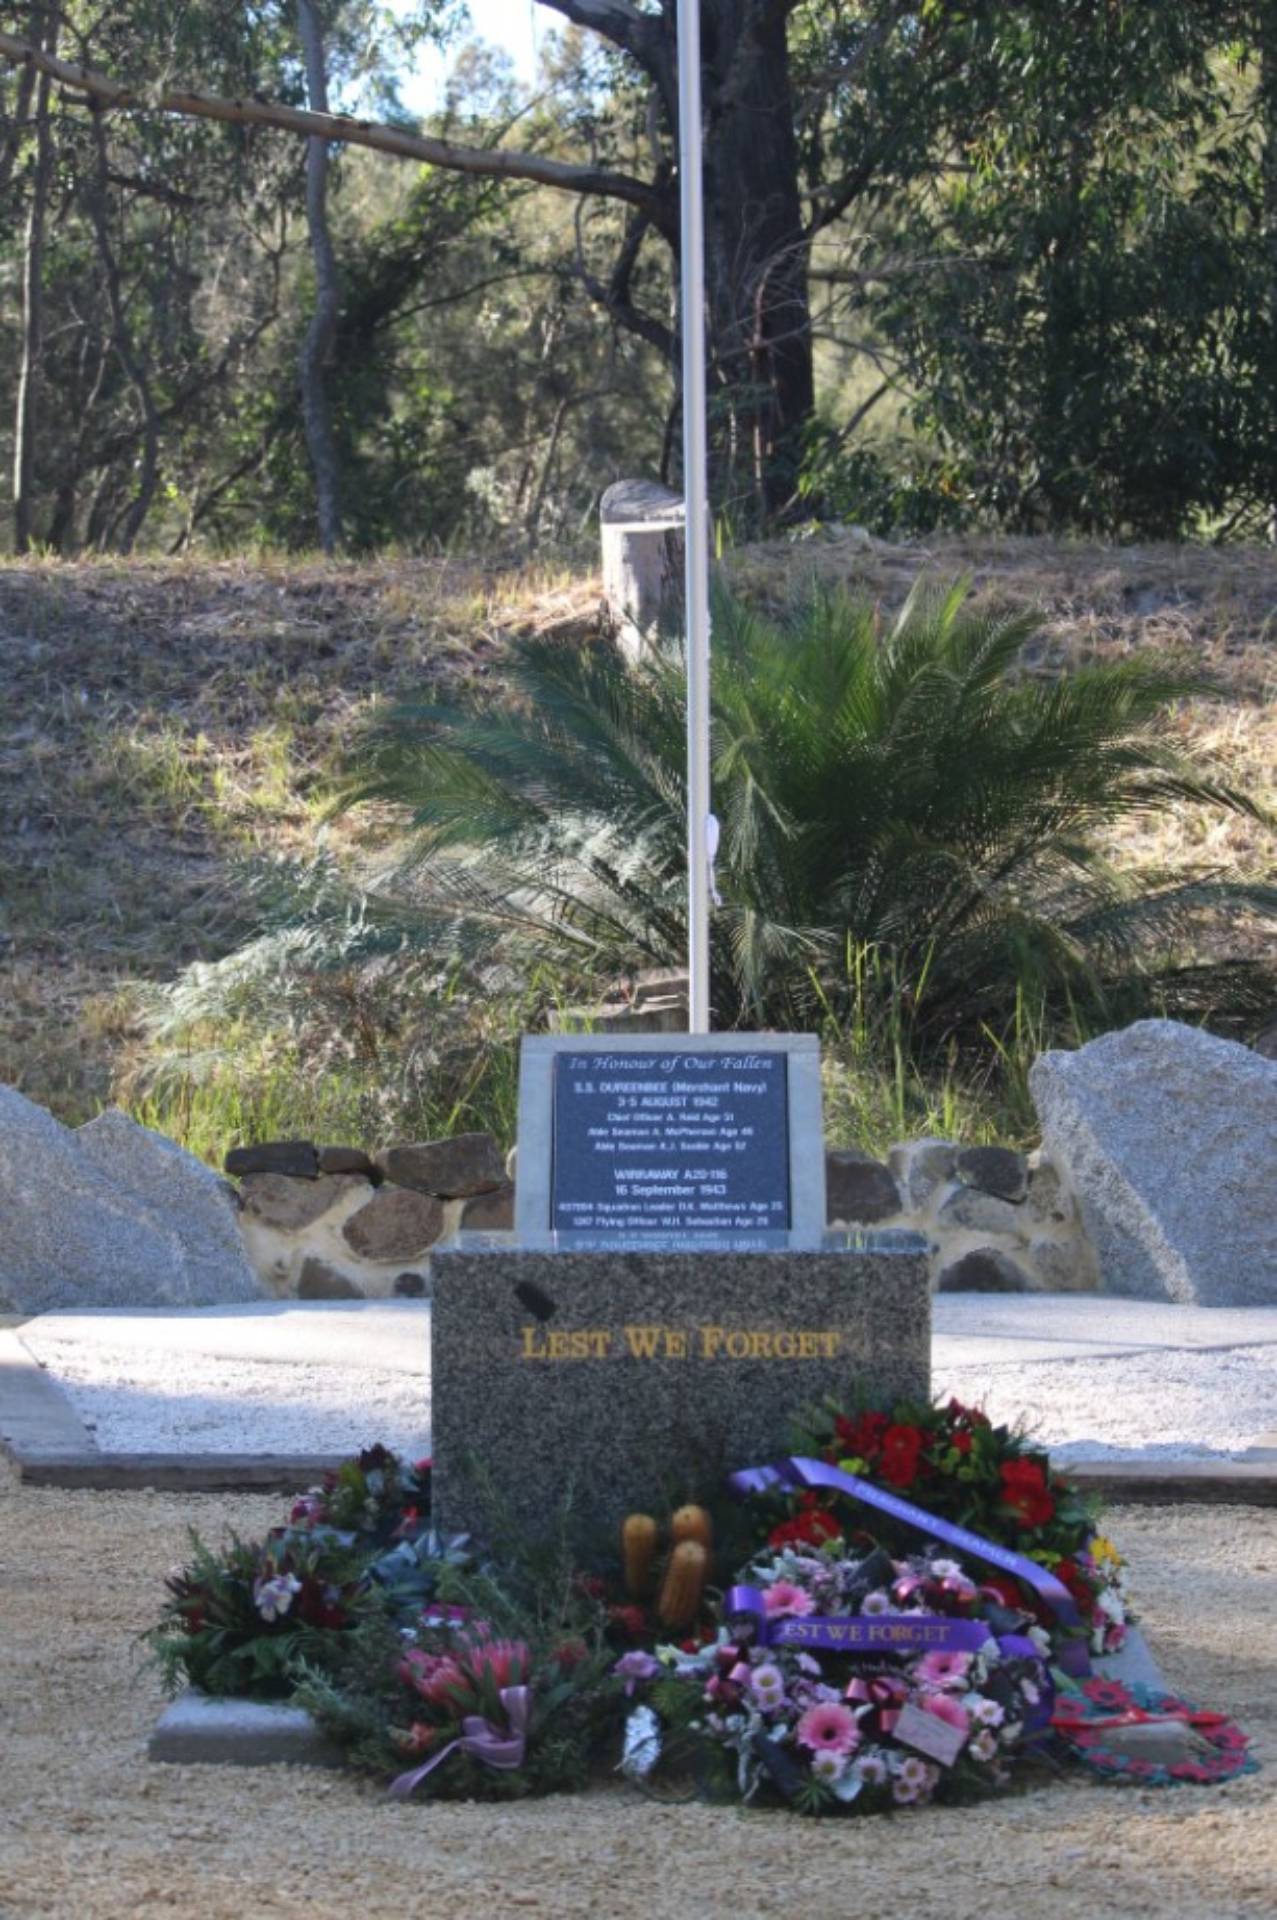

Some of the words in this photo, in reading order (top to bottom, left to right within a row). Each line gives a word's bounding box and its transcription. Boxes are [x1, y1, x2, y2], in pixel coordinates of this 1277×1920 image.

[569, 1057, 588, 1070] In
[592, 1056, 657, 1070] Honour
[659, 1055, 682, 1073] of
[684, 1057, 717, 1070] Our
[720, 1055, 773, 1070] Fallen
[640, 1096, 687, 1107] AUGUST
[615, 1184, 628, 1197] 16
[630, 1184, 697, 1198] September
[521, 1326, 612, 1359] LEST
[624, 1325, 688, 1359] WE
[700, 1326, 841, 1359] FORGET
[779, 1623, 823, 1639] EST
[826, 1624, 862, 1642] WE
[868, 1624, 951, 1643] FORGET
